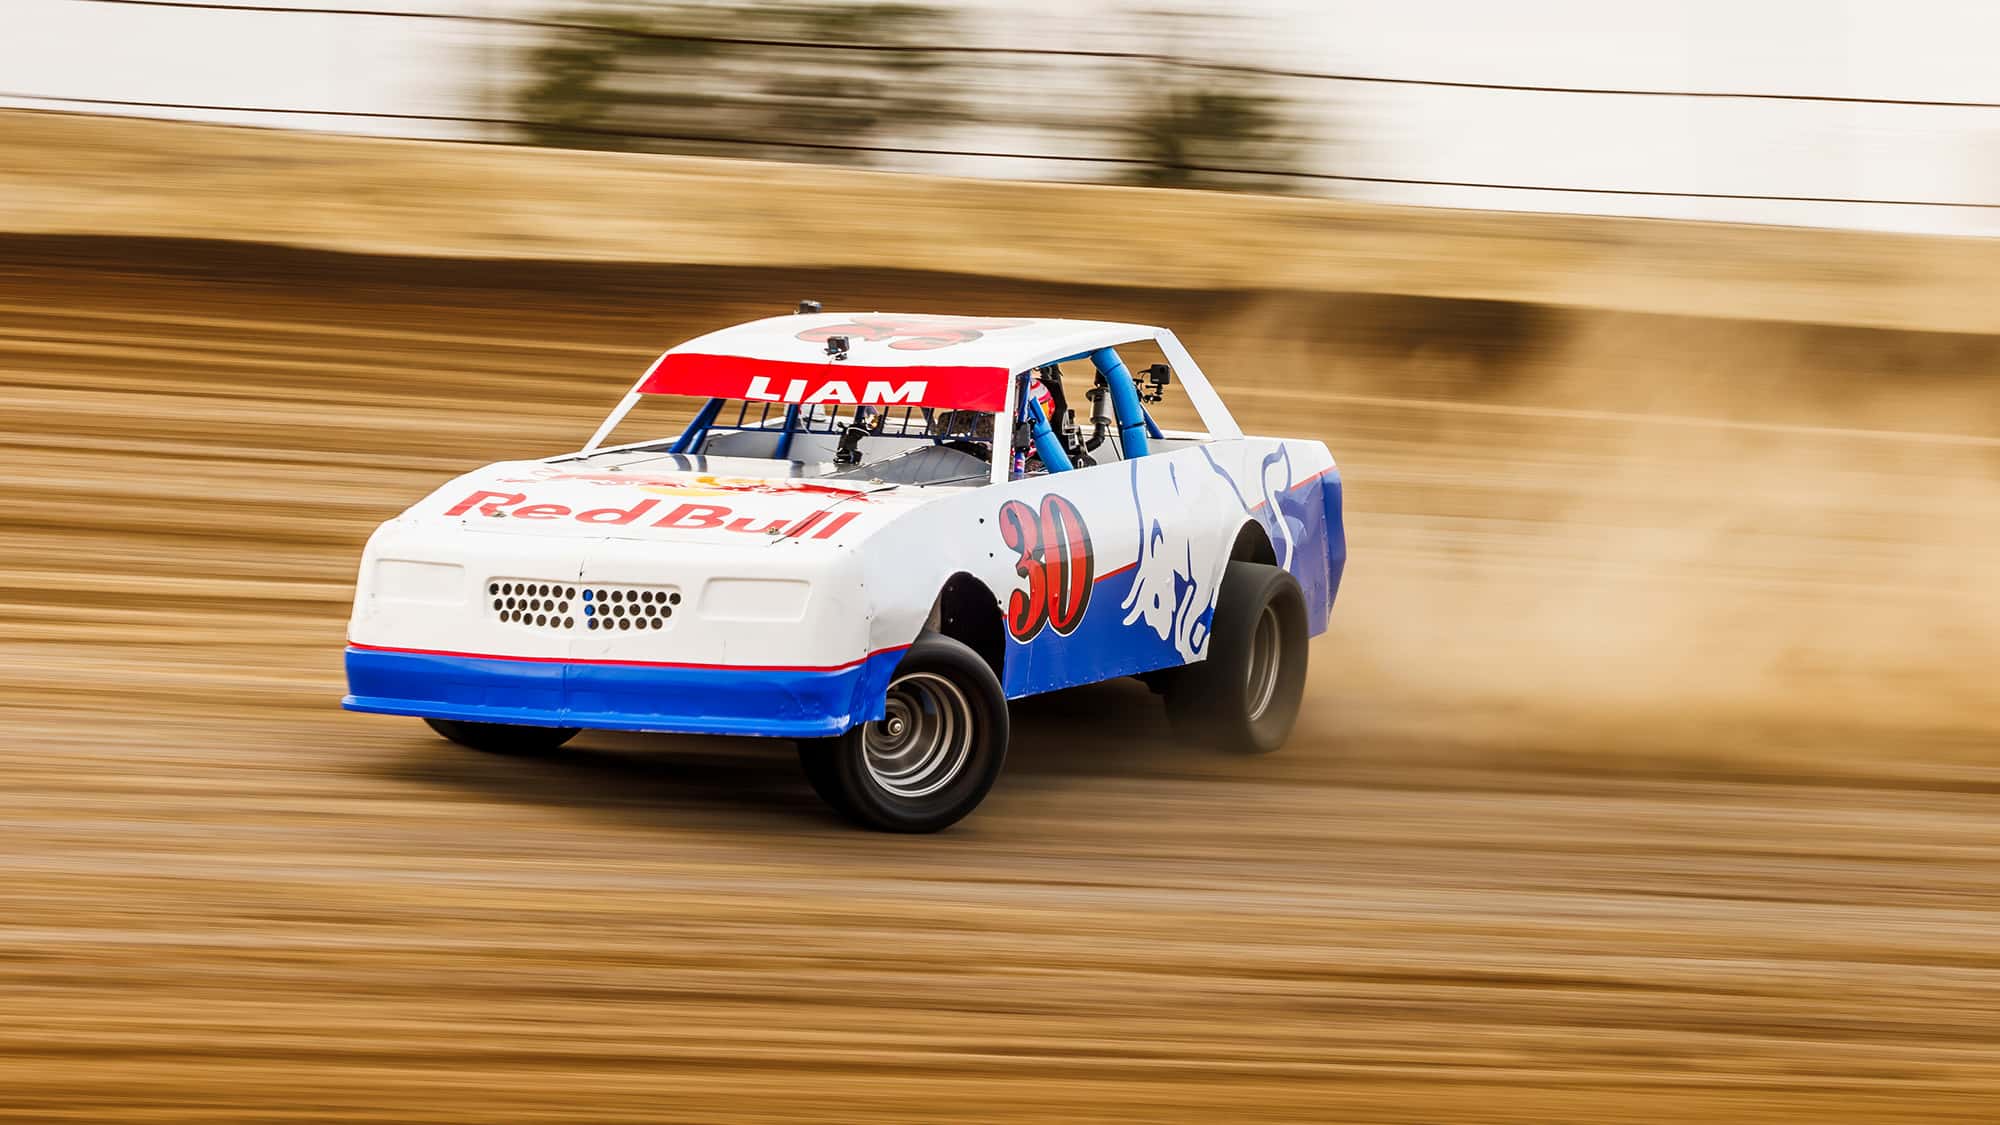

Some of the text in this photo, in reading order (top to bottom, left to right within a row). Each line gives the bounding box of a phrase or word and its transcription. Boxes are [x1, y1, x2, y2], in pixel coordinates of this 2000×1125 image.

[745, 376, 928, 404] LIAM
[443, 490, 863, 540] Red Bull
[998, 493, 1095, 644] 30
